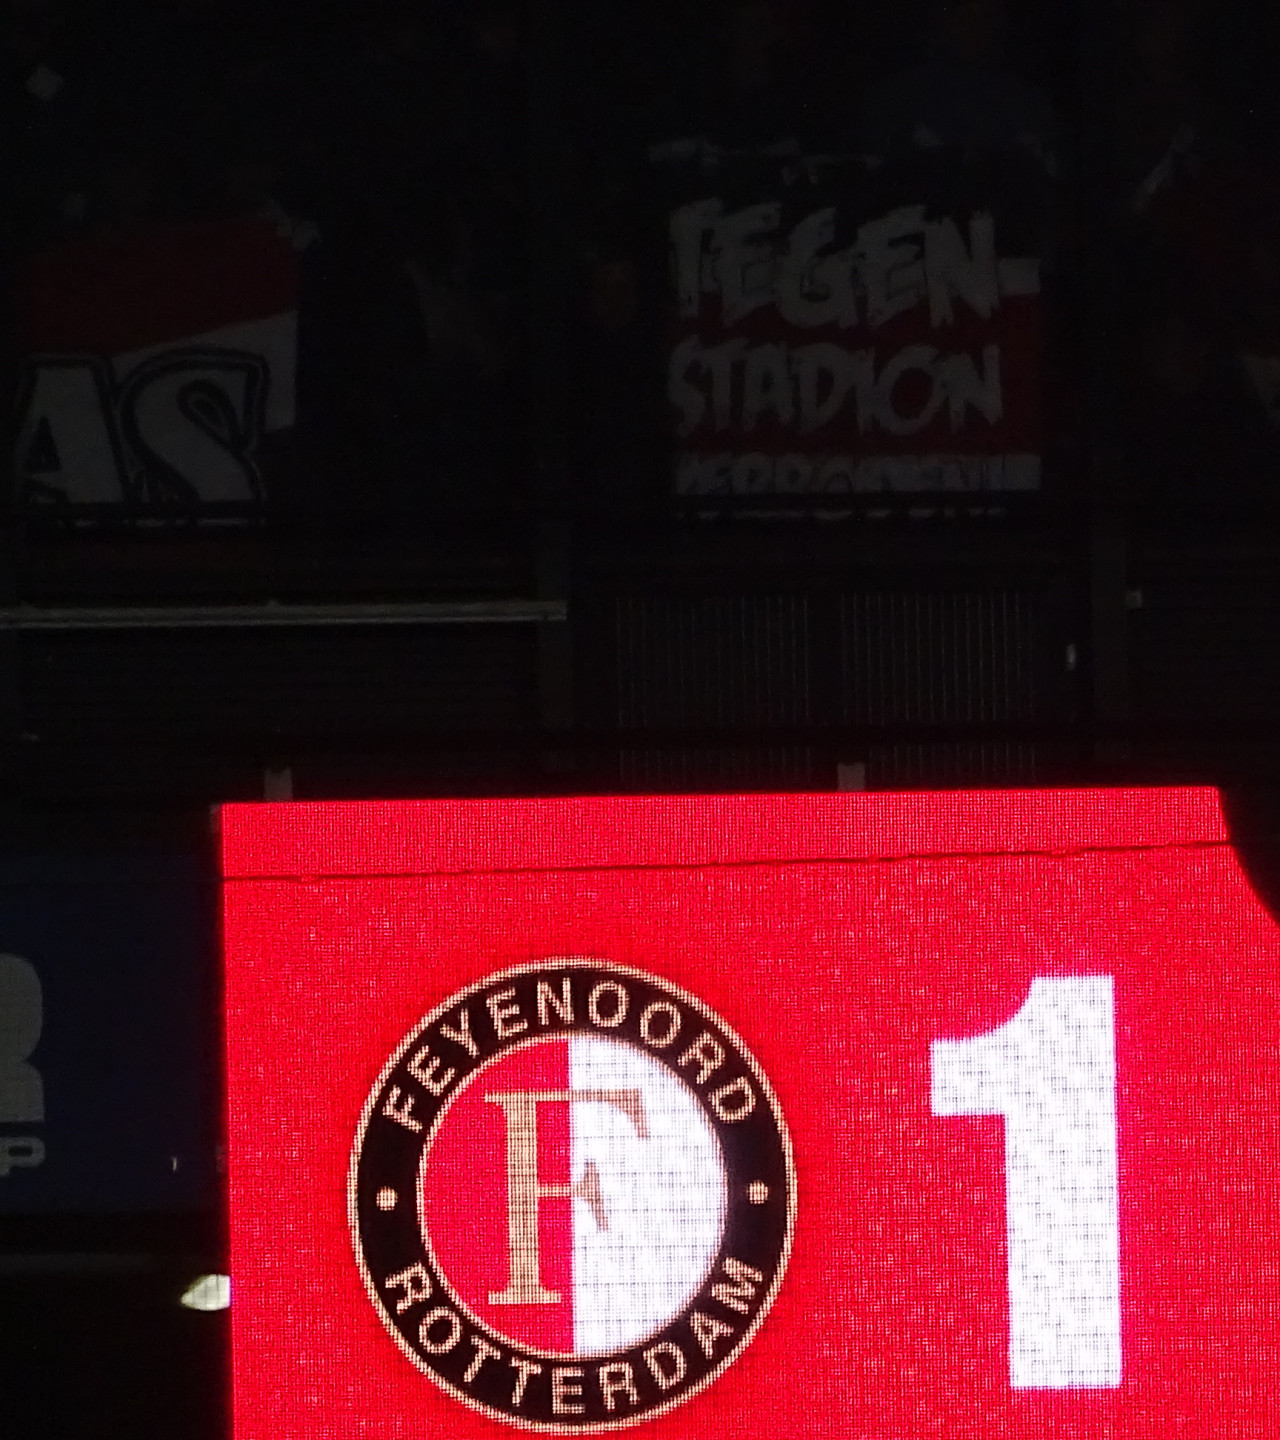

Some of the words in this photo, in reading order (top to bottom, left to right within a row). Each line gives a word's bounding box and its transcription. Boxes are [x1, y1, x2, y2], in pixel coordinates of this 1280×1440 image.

[667, 334, 1003, 437] STADION
[381, 977, 758, 1133] FEYENOORD
[483, 1088, 650, 1306] F
[930, 975, 1123, 1390] 1
[384, 1257, 766, 1415] ROTTERDAM
